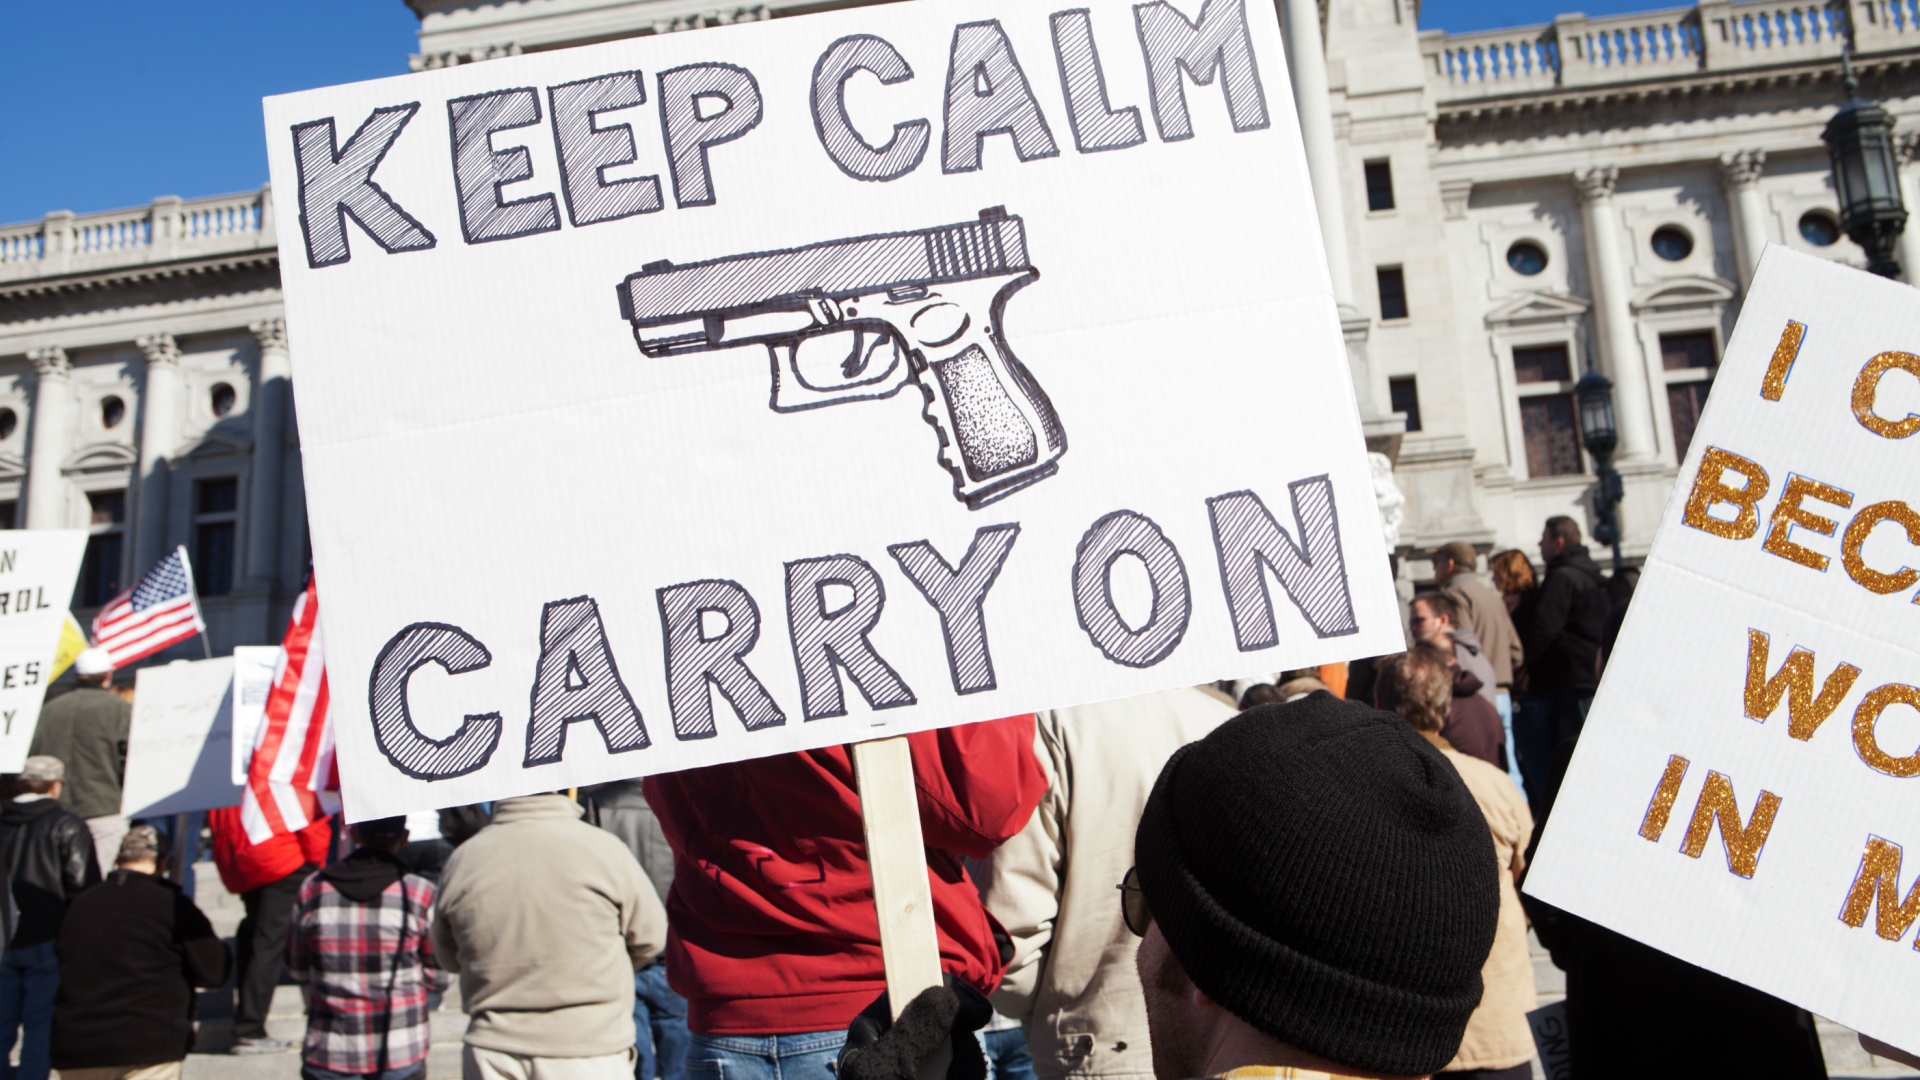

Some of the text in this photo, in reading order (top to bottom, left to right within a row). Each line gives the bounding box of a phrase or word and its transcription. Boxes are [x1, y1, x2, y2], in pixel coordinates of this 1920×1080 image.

[290, 0, 1270, 269] KEEP CALM
[1760, 319, 1808, 402] I
[1681, 445, 1920, 605] BEC
[368, 474, 1359, 782] CARRY ON
[1638, 753, 1783, 879] IN
